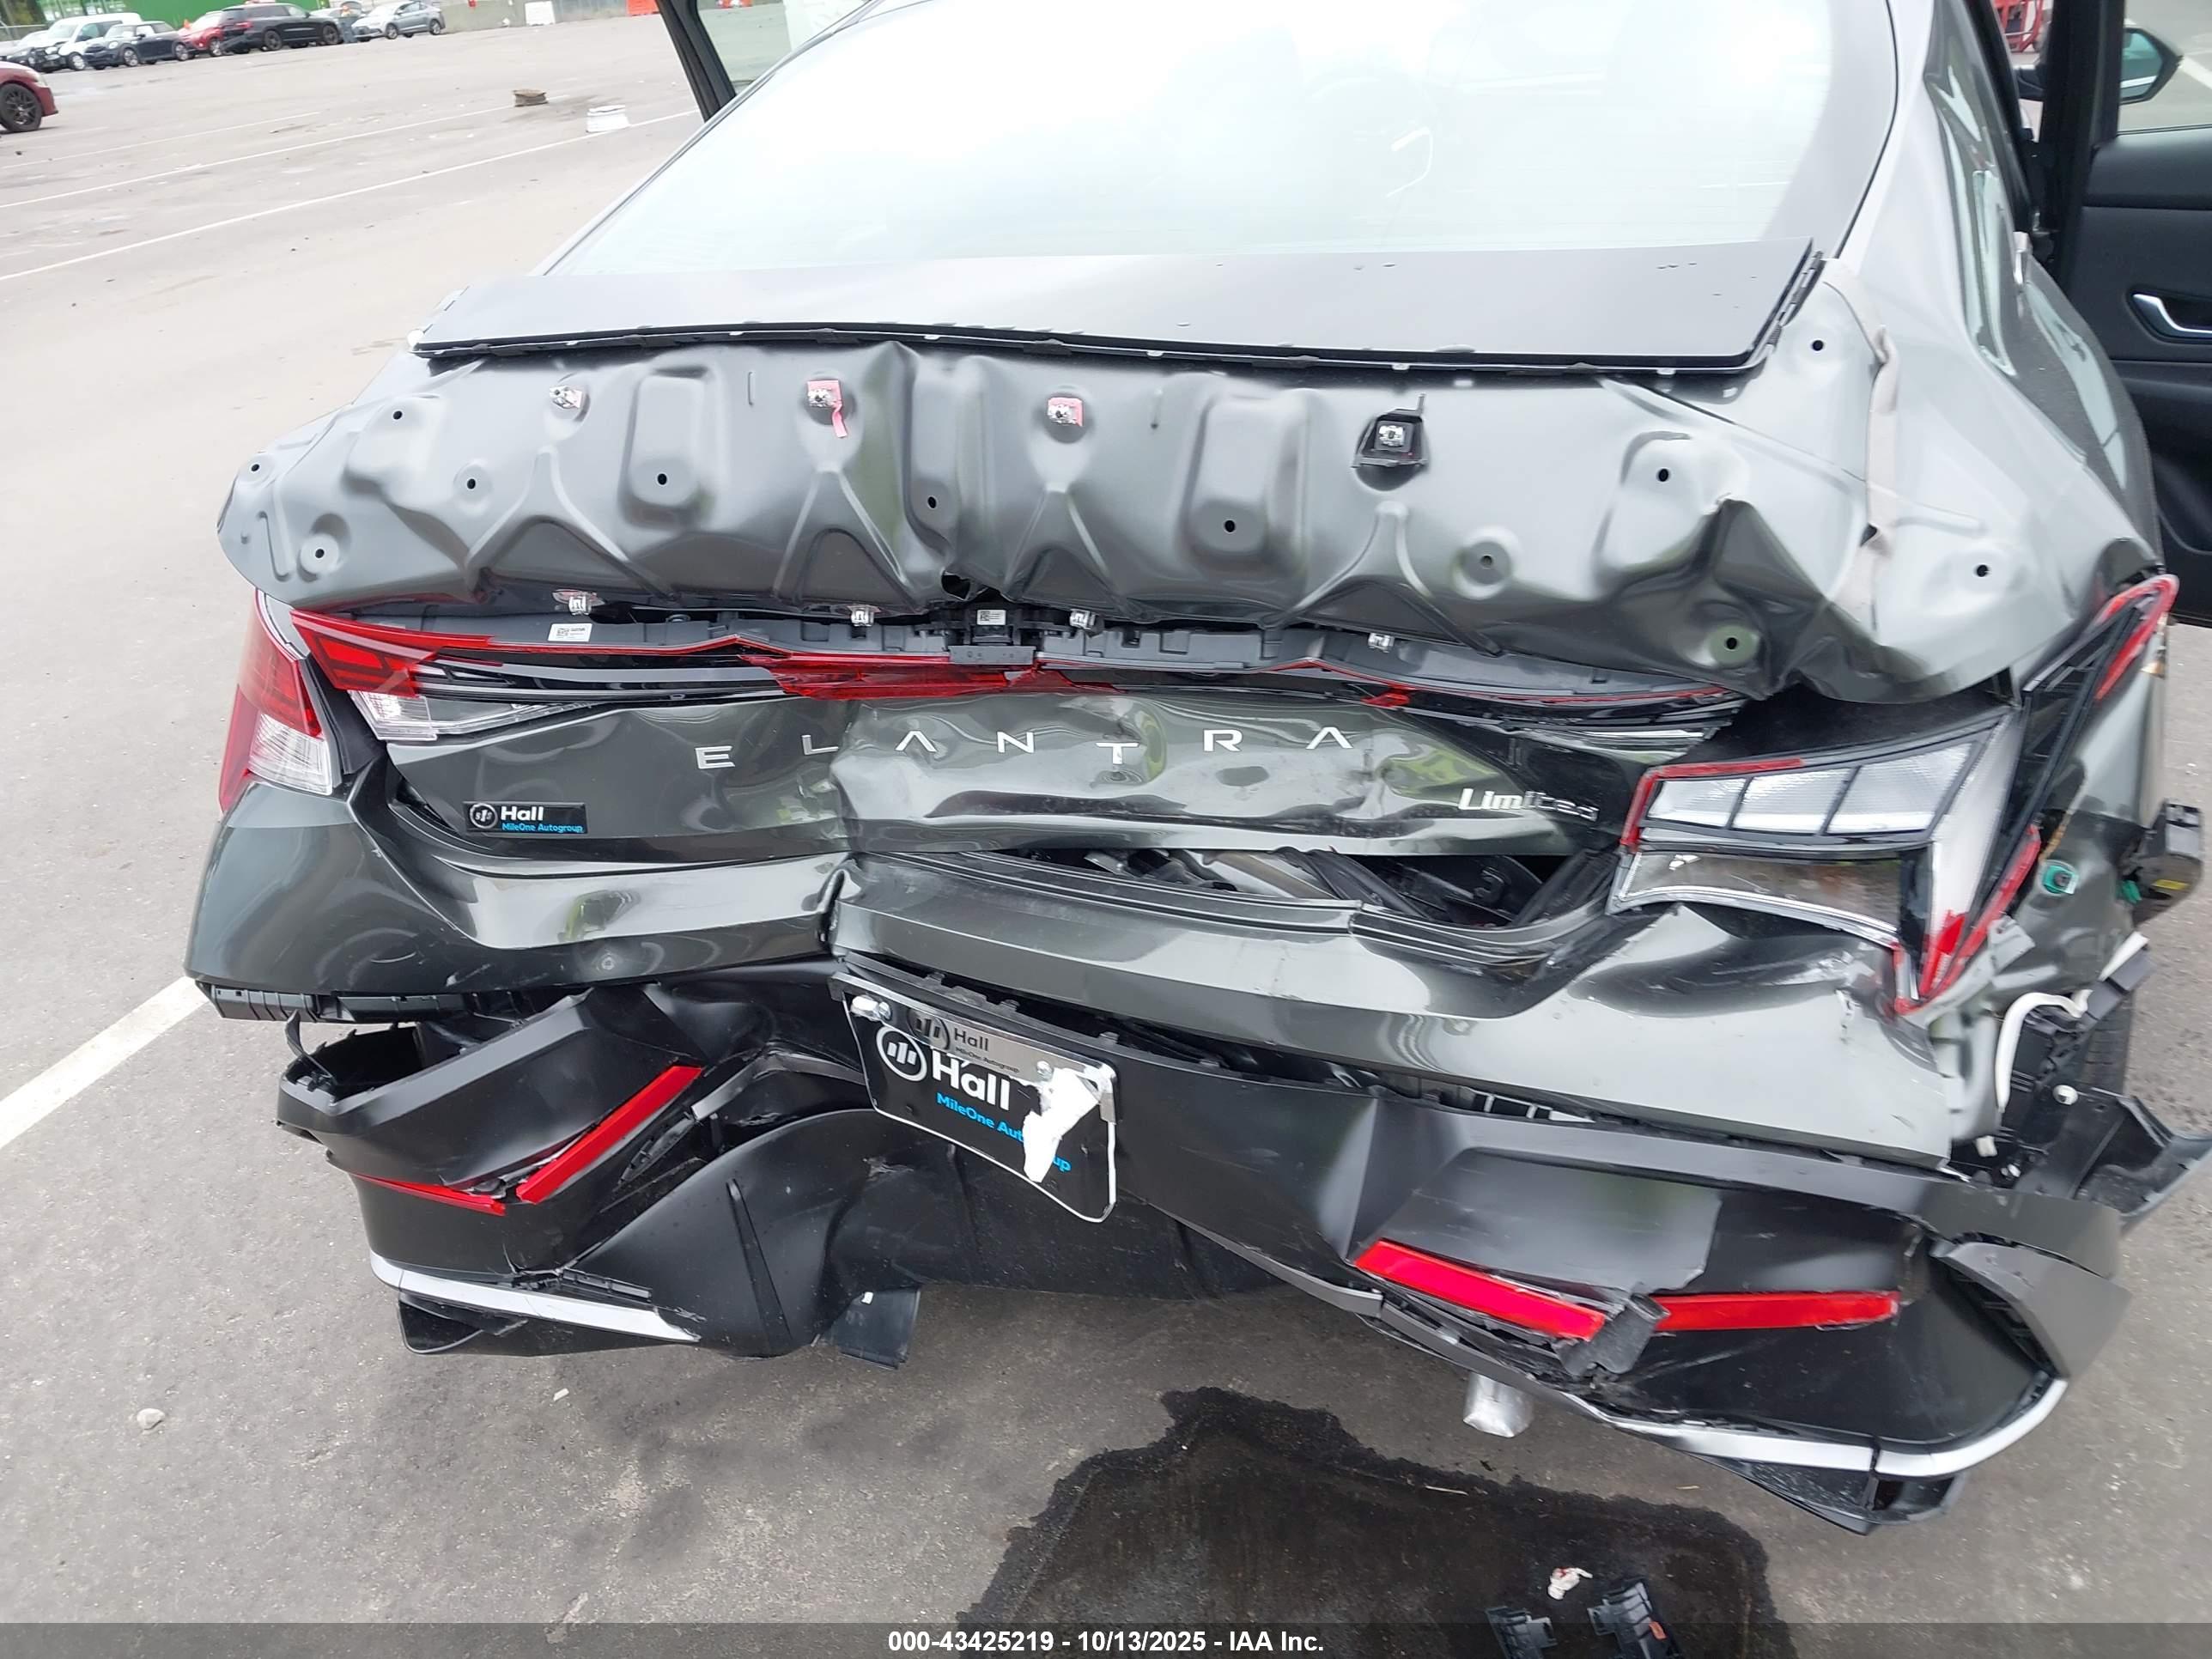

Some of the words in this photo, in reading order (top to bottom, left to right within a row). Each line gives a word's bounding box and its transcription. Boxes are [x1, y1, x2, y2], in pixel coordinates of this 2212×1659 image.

[696, 726, 1353, 769] ELANTRA
[500, 805, 544, 821] Hall
[501, 822, 536, 831] MileOne
[538, 823, 584, 833] Autogroup
[954, 1028, 989, 1051] Hall
[932, 1049, 1010, 1110] Hall
[936, 1092, 995, 1127] MileOne
